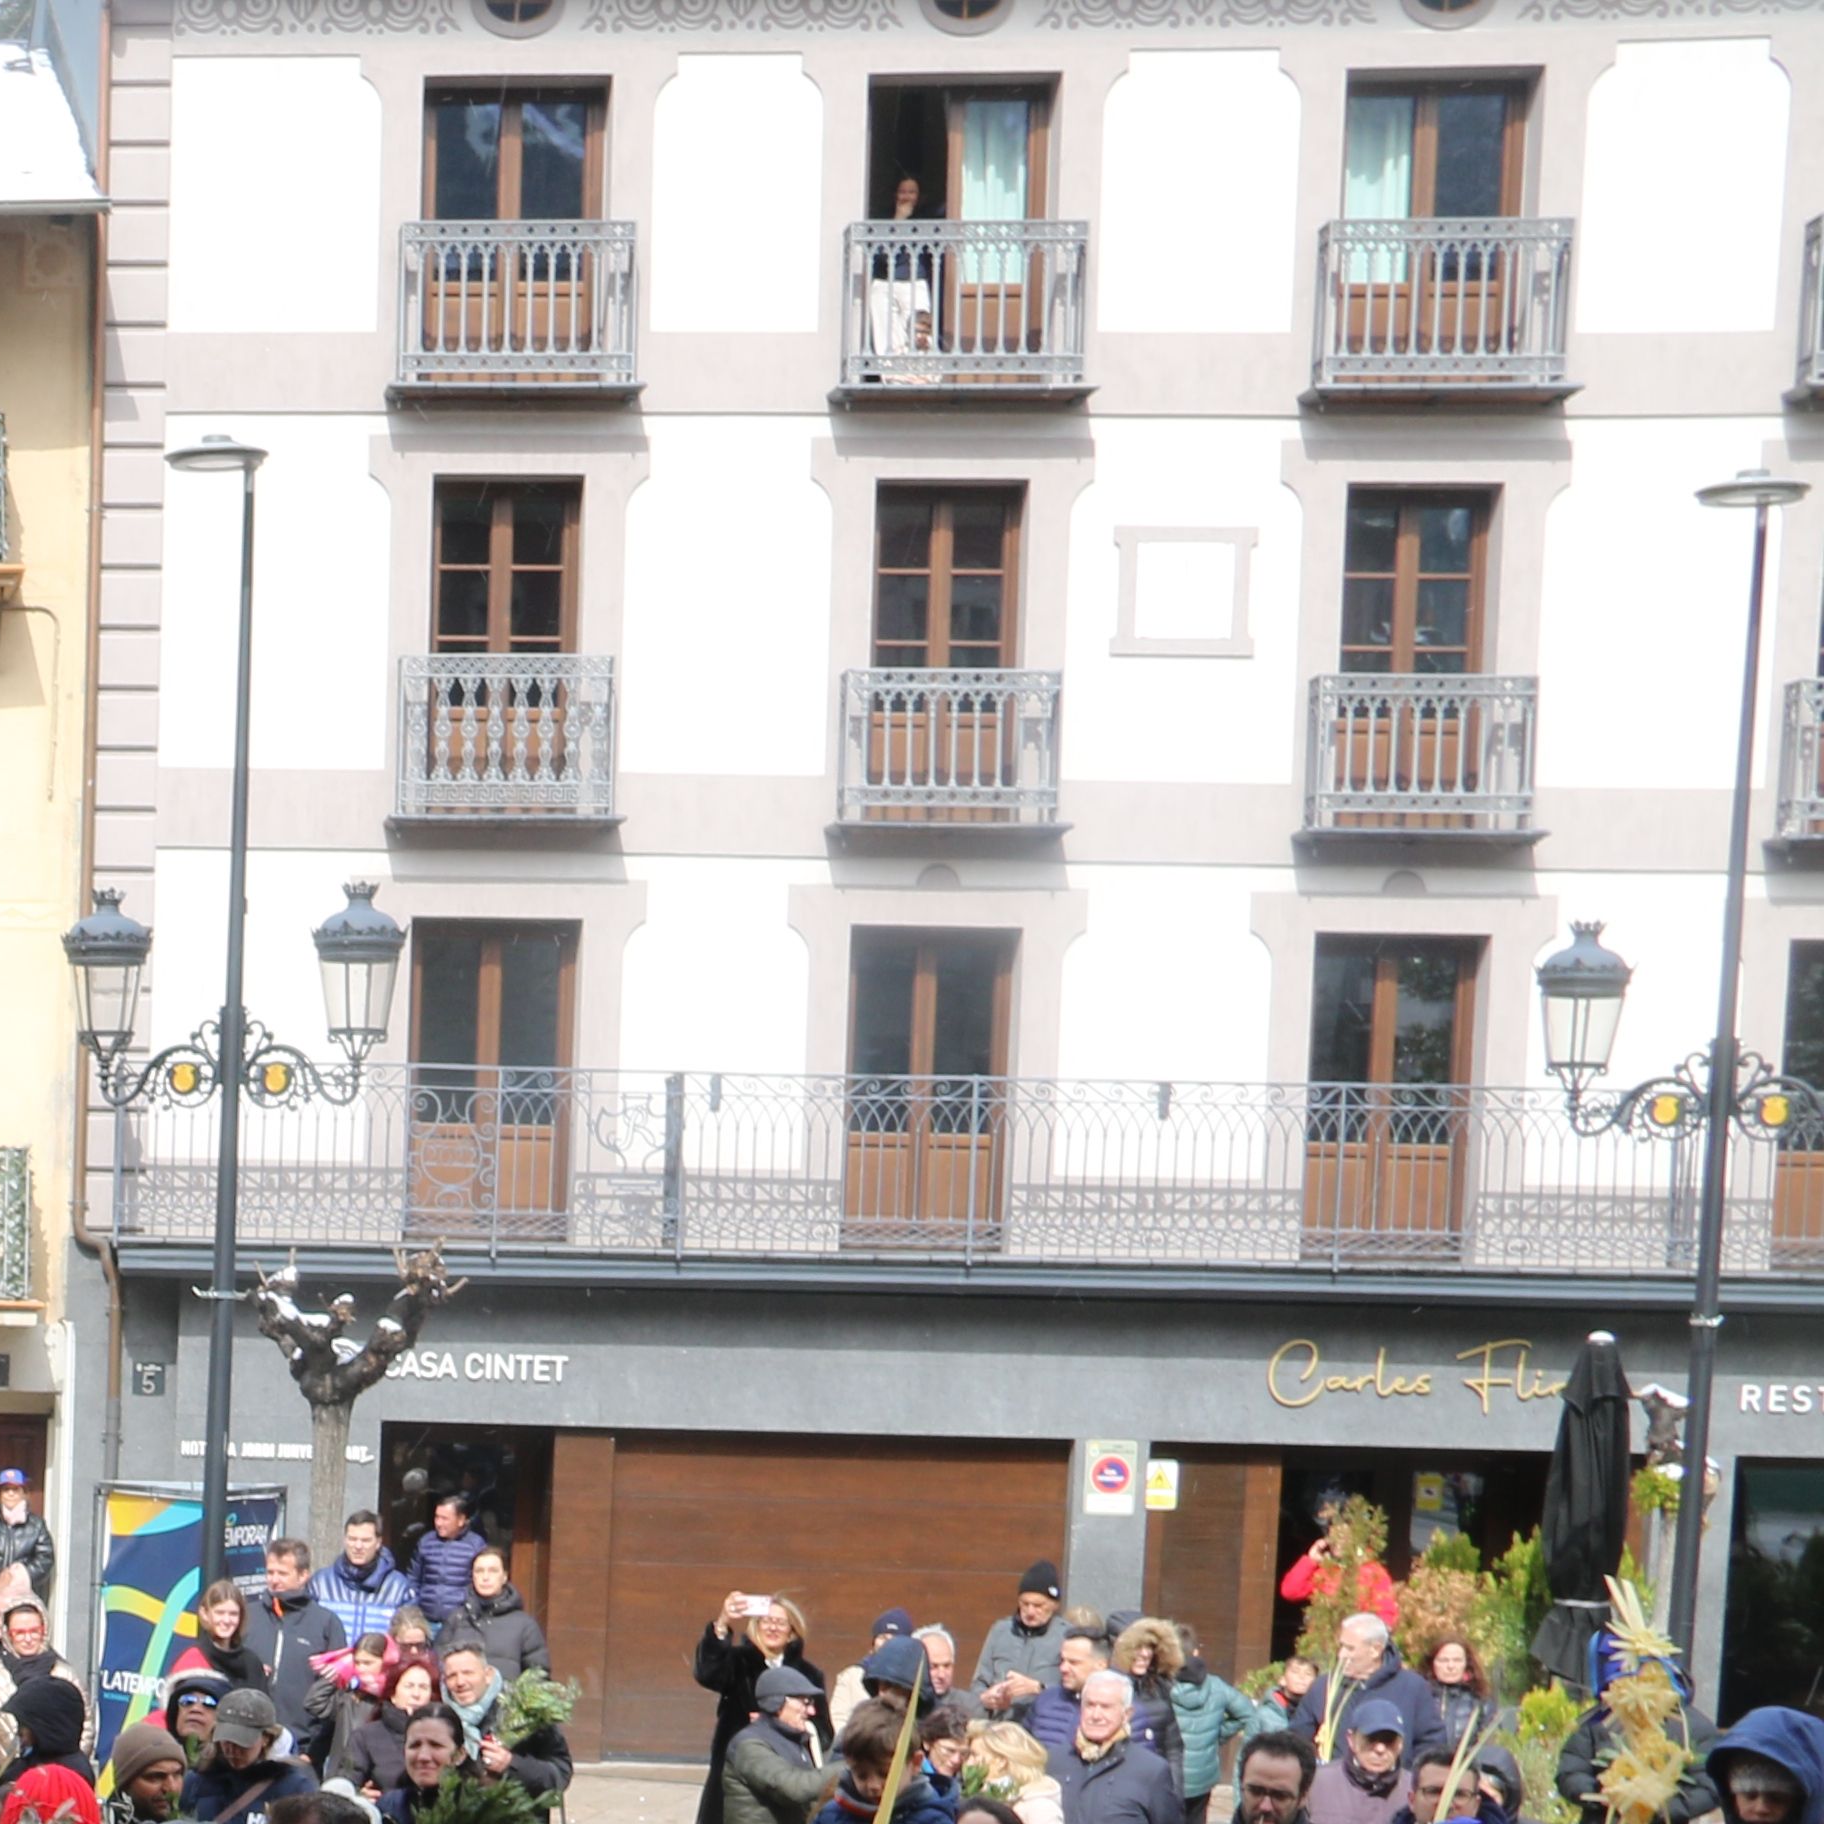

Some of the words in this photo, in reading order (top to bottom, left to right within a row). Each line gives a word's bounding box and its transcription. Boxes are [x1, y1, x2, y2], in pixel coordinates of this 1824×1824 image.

[141, 1371, 156, 1394] 5
[464, 1352, 570, 1383] CINTET
[1267, 1338, 1432, 1408] Carles
